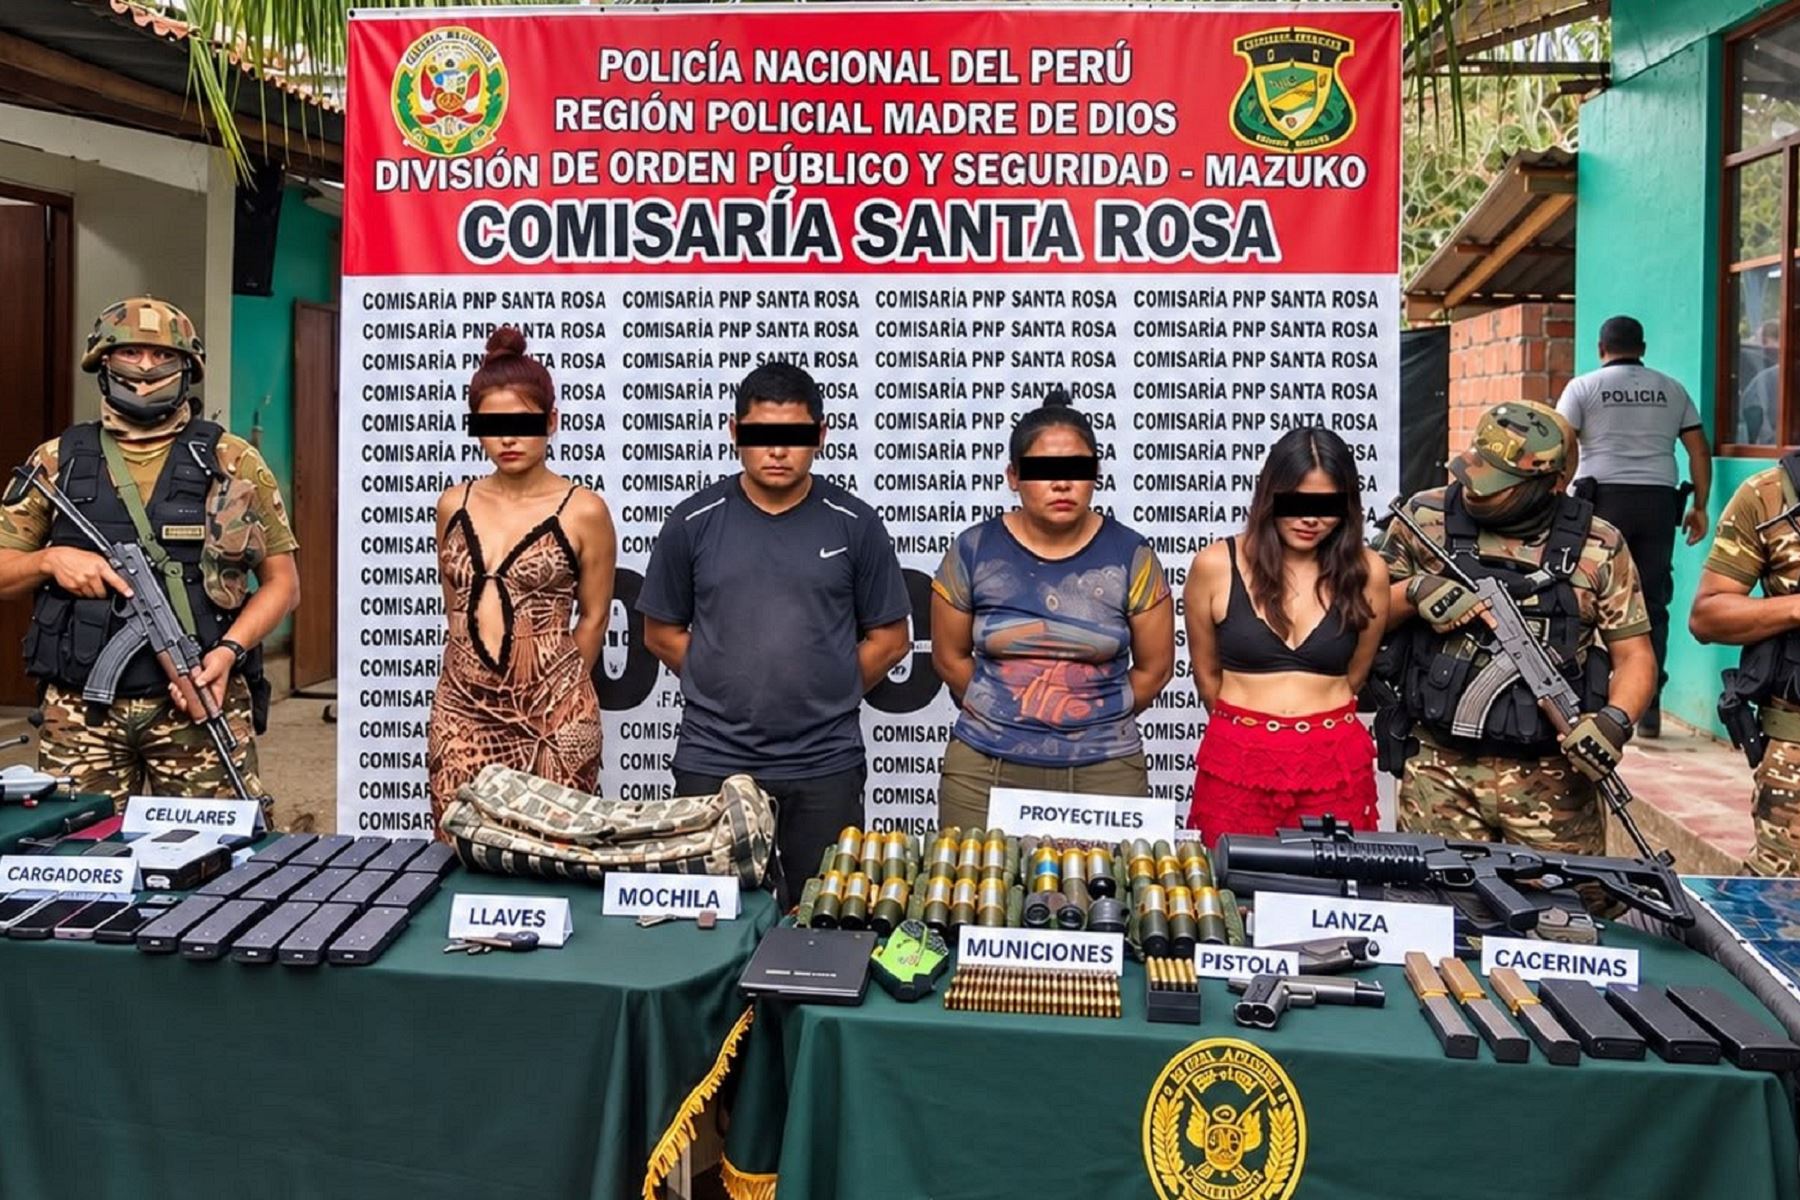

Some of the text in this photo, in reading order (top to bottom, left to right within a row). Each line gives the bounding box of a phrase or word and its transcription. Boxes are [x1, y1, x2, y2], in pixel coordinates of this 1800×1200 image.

[599, 39, 1132, 85] POLICÍA NACIONAL DEL PERÚ
[555, 90, 1177, 136] REGIÓN POLICIAL MADRE DE DIOS
[375, 147, 538, 191] DIVISIÓN
[551, 150, 599, 185] DE
[608, 149, 736, 185] ORDEN
[748, 143, 909, 186] PÚBLICO
[918, 152, 944, 186] Y
[953, 151, 1169, 187] SEGURIDAD
[1205, 153, 1367, 189] MAZUKO
[462, 186, 1281, 264] COMISARÍA SANTA ROSA
[463, 292, 496, 309] PNP
[502, 292, 555, 309] SANTA
[562, 291, 605, 308] ROSA
[720, 291, 751, 308] PNP
[757, 291, 809, 308] SANTA
[815, 291, 859, 308] ROSA
[973, 291, 1005, 307] PNP
[1012, 291, 1065, 307] SANTA
[1073, 290, 1116, 308] ROSA
[1233, 291, 1265, 307] PNP
[1271, 291, 1326, 308] SANTA
[1333, 291, 1378, 308] ROSA
[562, 322, 605, 338] ROSA
[719, 322, 751, 337] PNP
[757, 322, 809, 337] SANTA
[815, 321, 859, 337] ROSA
[973, 321, 1005, 337] PNP
[1012, 321, 1065, 337] SANTA
[1072, 321, 1116, 337] ROSA
[1233, 321, 1265, 337] PNP
[1271, 321, 1326, 337] SANTA
[1332, 322, 1378, 338] ROSA
[562, 353, 605, 369] ROSA
[719, 352, 751, 368] PNP
[814, 351, 858, 367] ROSA
[973, 351, 1004, 367] PNP
[1012, 351, 1065, 367] SANTA
[1072, 351, 1116, 367] ROSA
[1233, 352, 1265, 367] PNP
[1271, 351, 1325, 367] SANTA
[1332, 352, 1377, 368] ROSA
[562, 384, 605, 400] ROSA
[973, 383, 1004, 399] PNP
[1071, 382, 1116, 399] ROSA
[1233, 383, 1265, 399] PNP
[1271, 383, 1325, 399] SANTA
[1332, 383, 1377, 400] ROSA
[1602, 390, 1668, 403] POLICIA
[561, 413, 605, 431] ROSA
[825, 413, 859, 430] OSA
[972, 413, 1004, 429] PNP
[1233, 413, 1265, 430] PNP
[1270, 413, 1326, 430] SANTA
[1331, 414, 1377, 431] ROSA
[561, 444, 605, 461] ROSA
[972, 443, 1004, 459] PNP
[1232, 444, 1265, 461] PNP
[972, 474, 1004, 491] PNP
[361, 506, 437, 523] COMISAR
[622, 505, 672, 522] COMIS
[361, 536, 437, 554] COMISAR
[360, 655, 440, 676] COMISARÍ
[360, 690, 435, 707] COMISAR
[620, 722, 680, 739] COMISA
[620, 752, 671, 770] COMIS
[620, 784, 671, 800] COMIS
[873, 786, 936, 804] COMISA
[146, 808, 236, 825] CELULARES
[359, 813, 434, 830] COMISAR
[1020, 806, 1143, 828] PROYECTILES
[873, 818, 936, 835] COMISA
[8, 867, 122, 883] CARGADORES
[619, 888, 719, 908] MOCHILA
[470, 908, 545, 927] LLAVES
[1313, 910, 1388, 933] LANZA
[966, 938, 1113, 964] MUNICIONES
[1200, 953, 1289, 975] PISTOLA
[1495, 949, 1627, 977] CACERINAS
